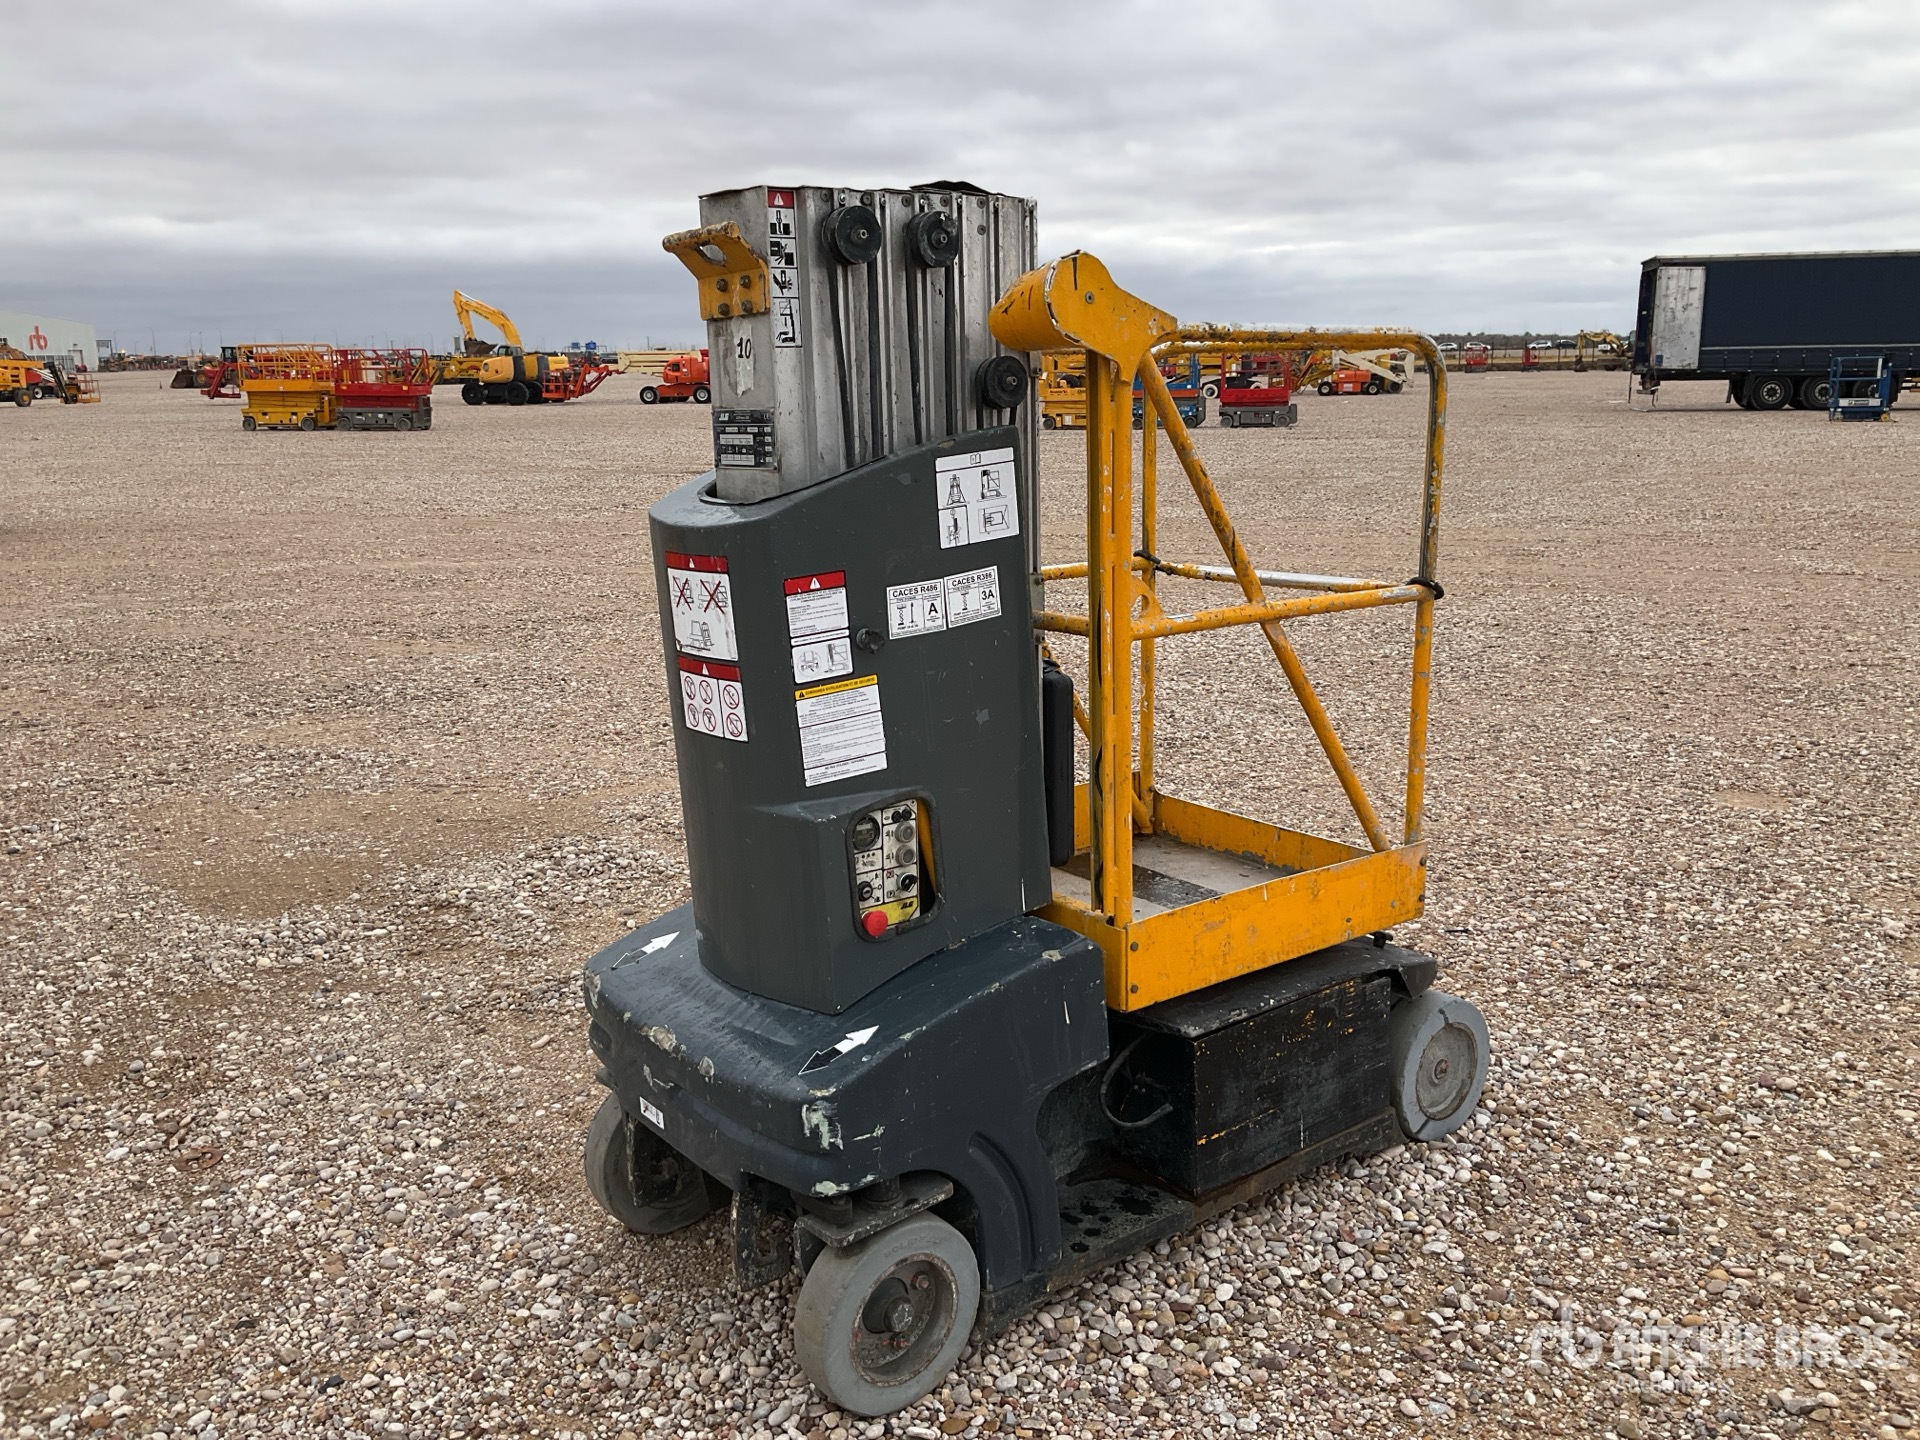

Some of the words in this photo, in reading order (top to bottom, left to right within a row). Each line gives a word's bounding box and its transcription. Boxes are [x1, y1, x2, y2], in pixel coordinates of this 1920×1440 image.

[737, 336, 752, 359] 10
[952, 576, 975, 587] CACES
[977, 572, 993, 581] R386
[892, 587, 919, 598] CACES
[920, 584, 938, 594] R486
[981, 589, 995, 600] 3A
[928, 602, 938, 615] A
[901, 901, 914, 909] JLG
